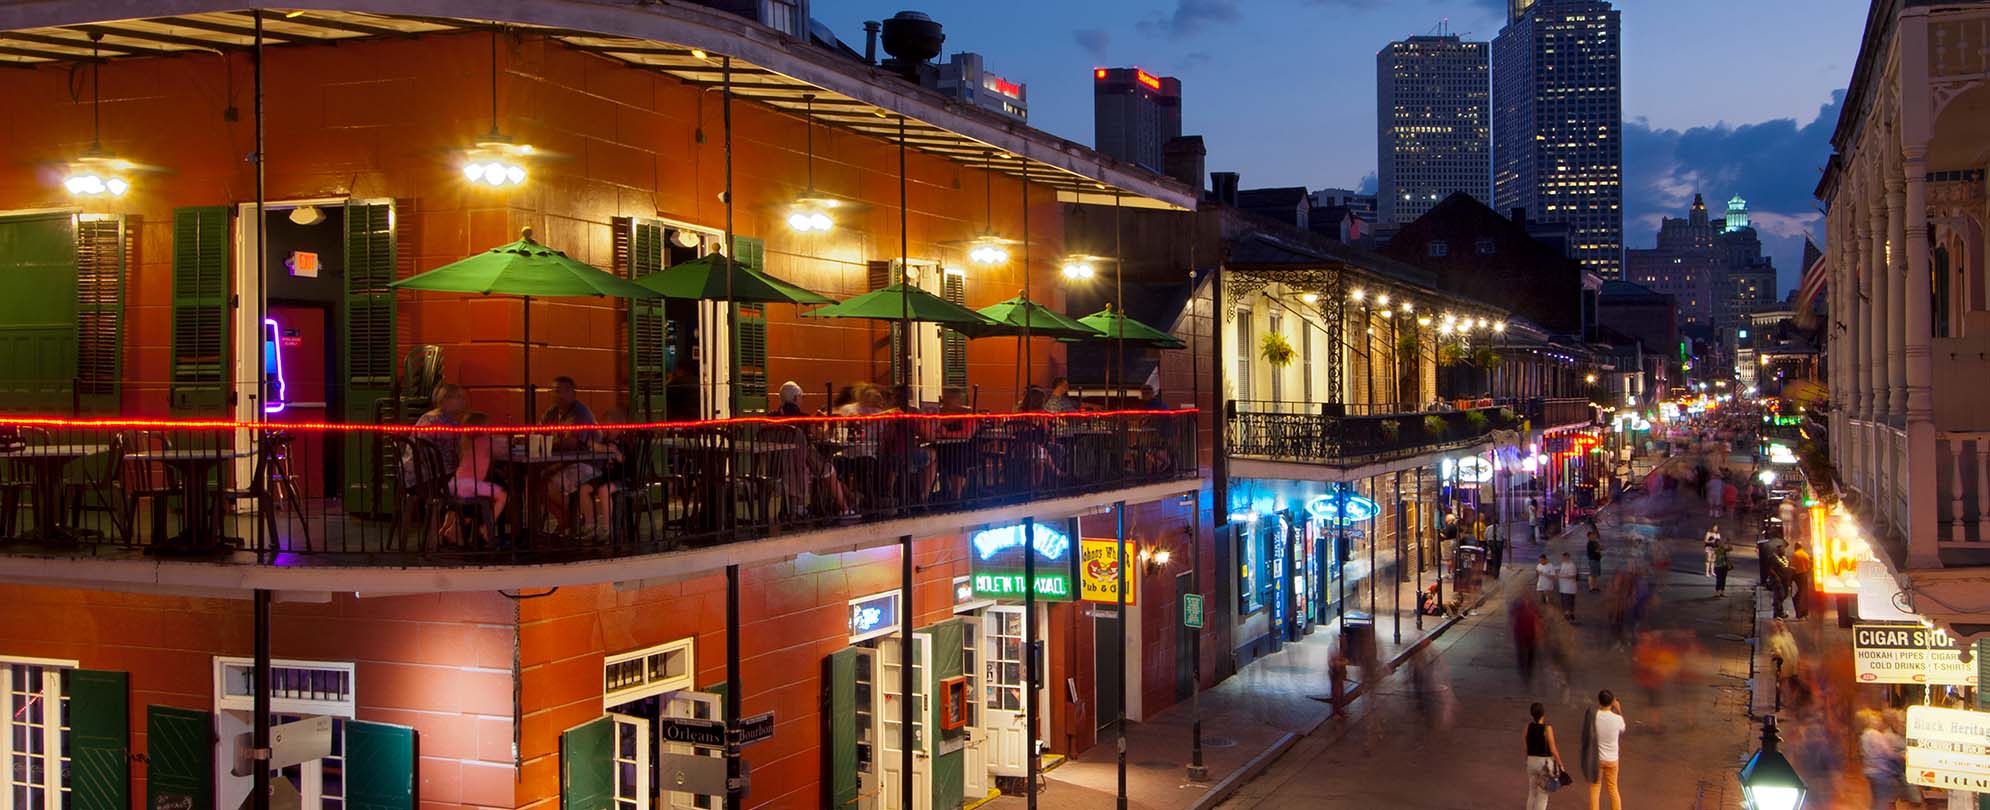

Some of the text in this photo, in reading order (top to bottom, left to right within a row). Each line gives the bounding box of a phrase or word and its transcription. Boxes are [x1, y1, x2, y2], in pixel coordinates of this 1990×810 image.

[1860, 630, 1909, 646] CIGAR
[1858, 651, 1893, 659] HOOKAH
[1900, 651, 1924, 660] PIPES
[1870, 661, 1892, 670] COLD
[1895, 662, 1926, 671] DRINKS
[667, 725, 720, 743] Orleans
[740, 724, 773, 741] Bourbon
